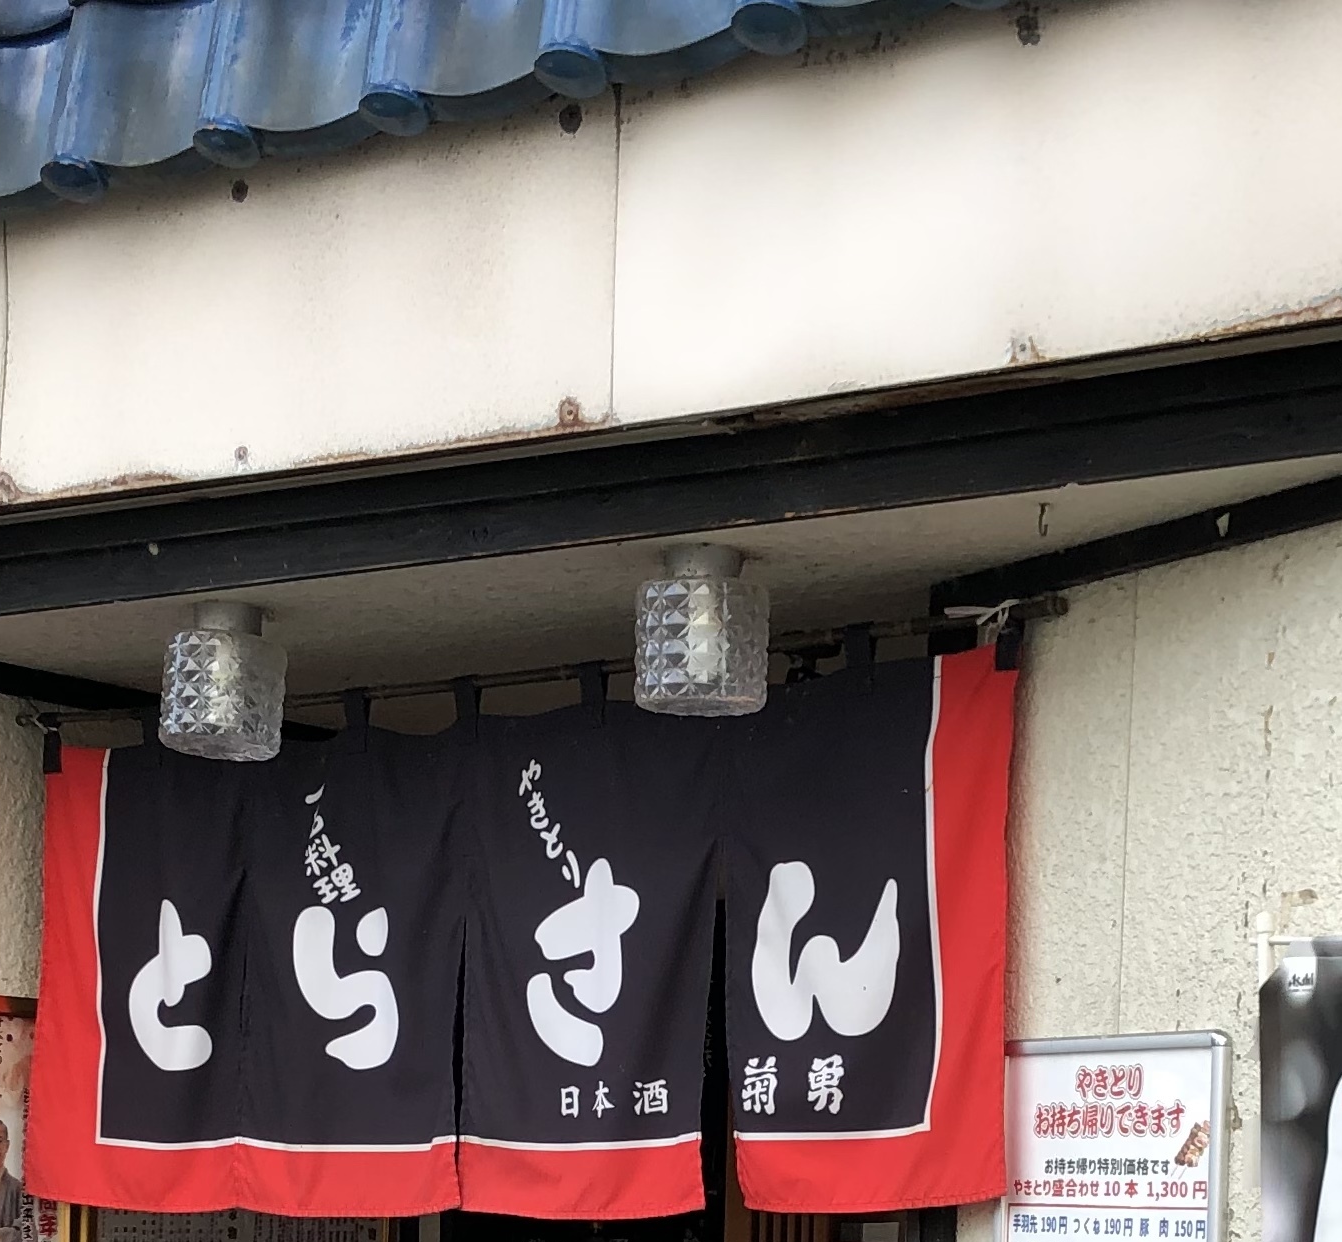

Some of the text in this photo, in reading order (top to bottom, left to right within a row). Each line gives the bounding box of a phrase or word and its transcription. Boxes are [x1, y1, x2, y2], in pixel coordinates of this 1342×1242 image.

[518, 760, 582, 888] やきとり
[129, 857, 900, 1070] とらさん
[560, 1055, 844, 1117] 日本酒 菊勇
[1075, 1064, 1144, 1101] やきとり
[1033, 1100, 1186, 1139] お持ち帰りできます
[1044, 1158, 1170, 1175] お持ち帰り特別価格です
[1014, 1179, 1099, 1197] やきとり盛合わせ
[1013, 1215, 1038, 1233] 手羽先
[1041, 1216, 1068, 1234] 190円
[1073, 1218, 1100, 1234] つくね
[1104, 1218, 1133, 1237] 190円
[1175, 1220, 1206, 1239] 150円
